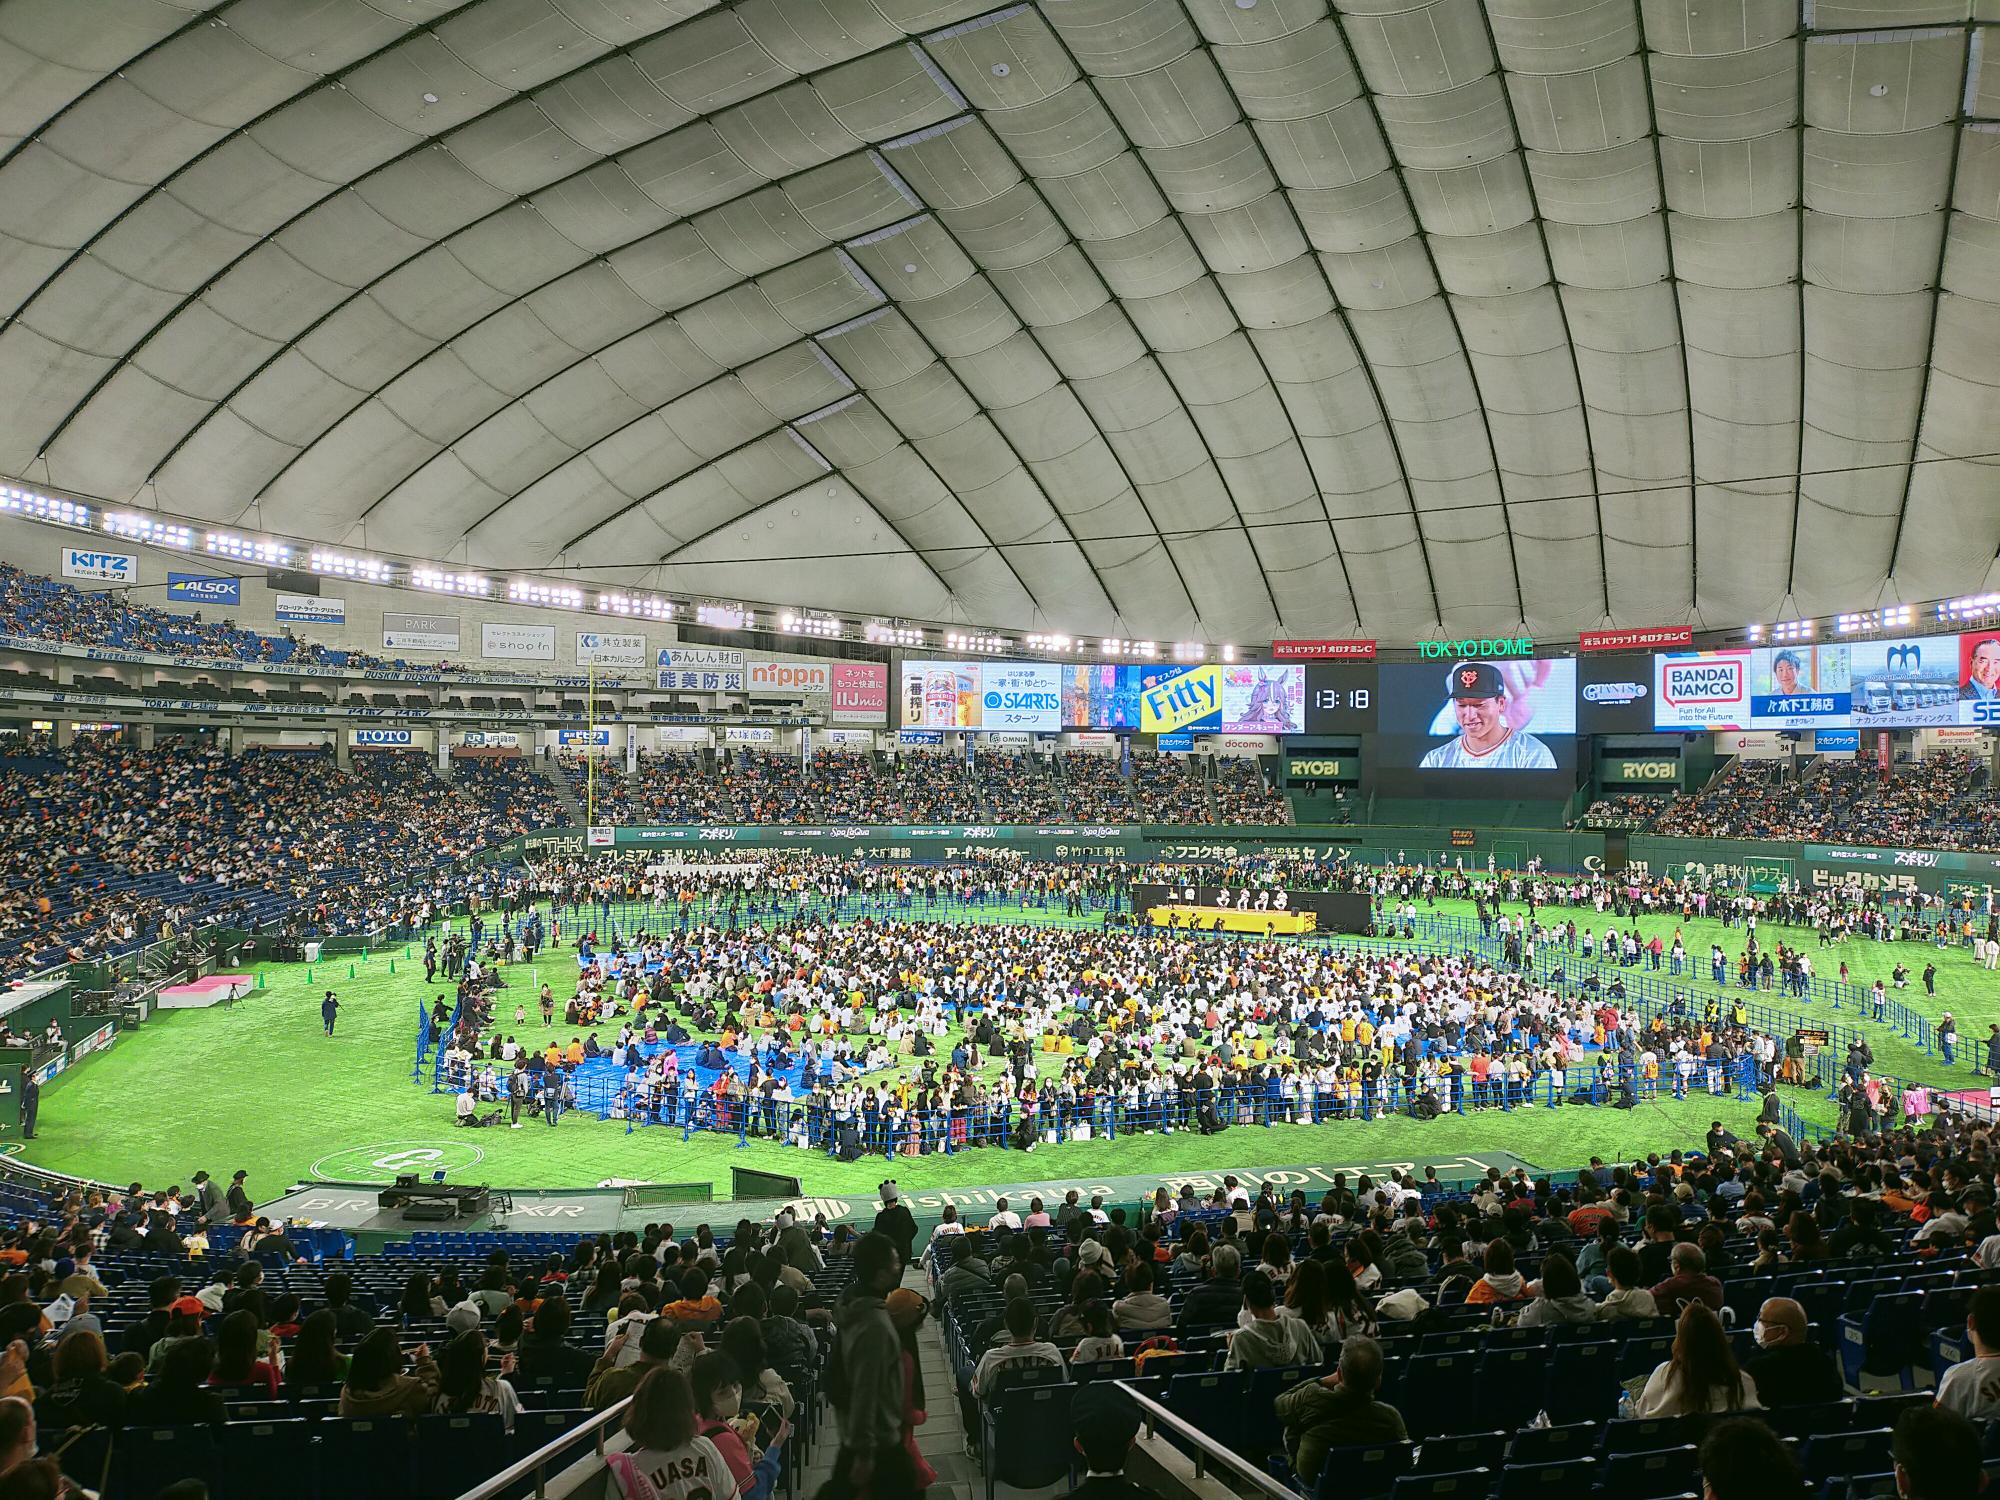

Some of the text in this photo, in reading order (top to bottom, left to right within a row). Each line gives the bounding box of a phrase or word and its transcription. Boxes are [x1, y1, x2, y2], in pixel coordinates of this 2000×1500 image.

[71, 551, 129, 571] KITZ
[99, 570, 126, 580] キッツ
[185, 581, 237, 595] ALSOK
[405, 619, 438, 630] PARK
[602, 637, 642, 648] 共立製薬
[1638, 631, 1689, 643] オロナミンC
[499, 641, 534, 652] shop
[1328, 645, 1373, 654] オロナミンC
[1416, 637, 1534, 658] TOKYO DOME
[594, 654, 645, 664] 日本カルミック
[670, 651, 742, 665] あんしん財団
[363, 670, 442, 682] DUSKIN DUSKIN
[659, 671, 741, 690] 能美防災
[752, 664, 825, 687] nippn
[846, 669, 876, 678] ネットを
[1156, 666, 1183, 682] マスクは
[1671, 667, 1733, 682] BANDAI
[837, 680, 884, 689] もっと快適に
[1671, 682, 1734, 697] NAMCO
[835, 691, 883, 707] IIJmio
[910, 676, 923, 723] 一番搾り
[1004, 692, 1060, 710] STARTS
[1146, 674, 1215, 721] Fitty
[1778, 697, 1834, 712] 木下工務店
[1004, 714, 1040, 724] スターツ
[1855, 714, 1953, 725] ナカシマホールディングス
[360, 730, 410, 742] TOTO
[727, 730, 773, 740] 大塚商会
[1225, 739, 1264, 749] docomo
[1780, 744, 1790, 752] 34
[1290, 760, 1339, 776] RYOBI
[1622, 762, 1676, 778] RYOBI
[1587, 817, 1641, 828] 日本アンテナ
[542, 836, 584, 854] THK
[1175, 845, 1238, 859] フコク生命
[1302, 846, 1352, 860] セノン
[1812, 869, 1916, 892] ビックカメラ
